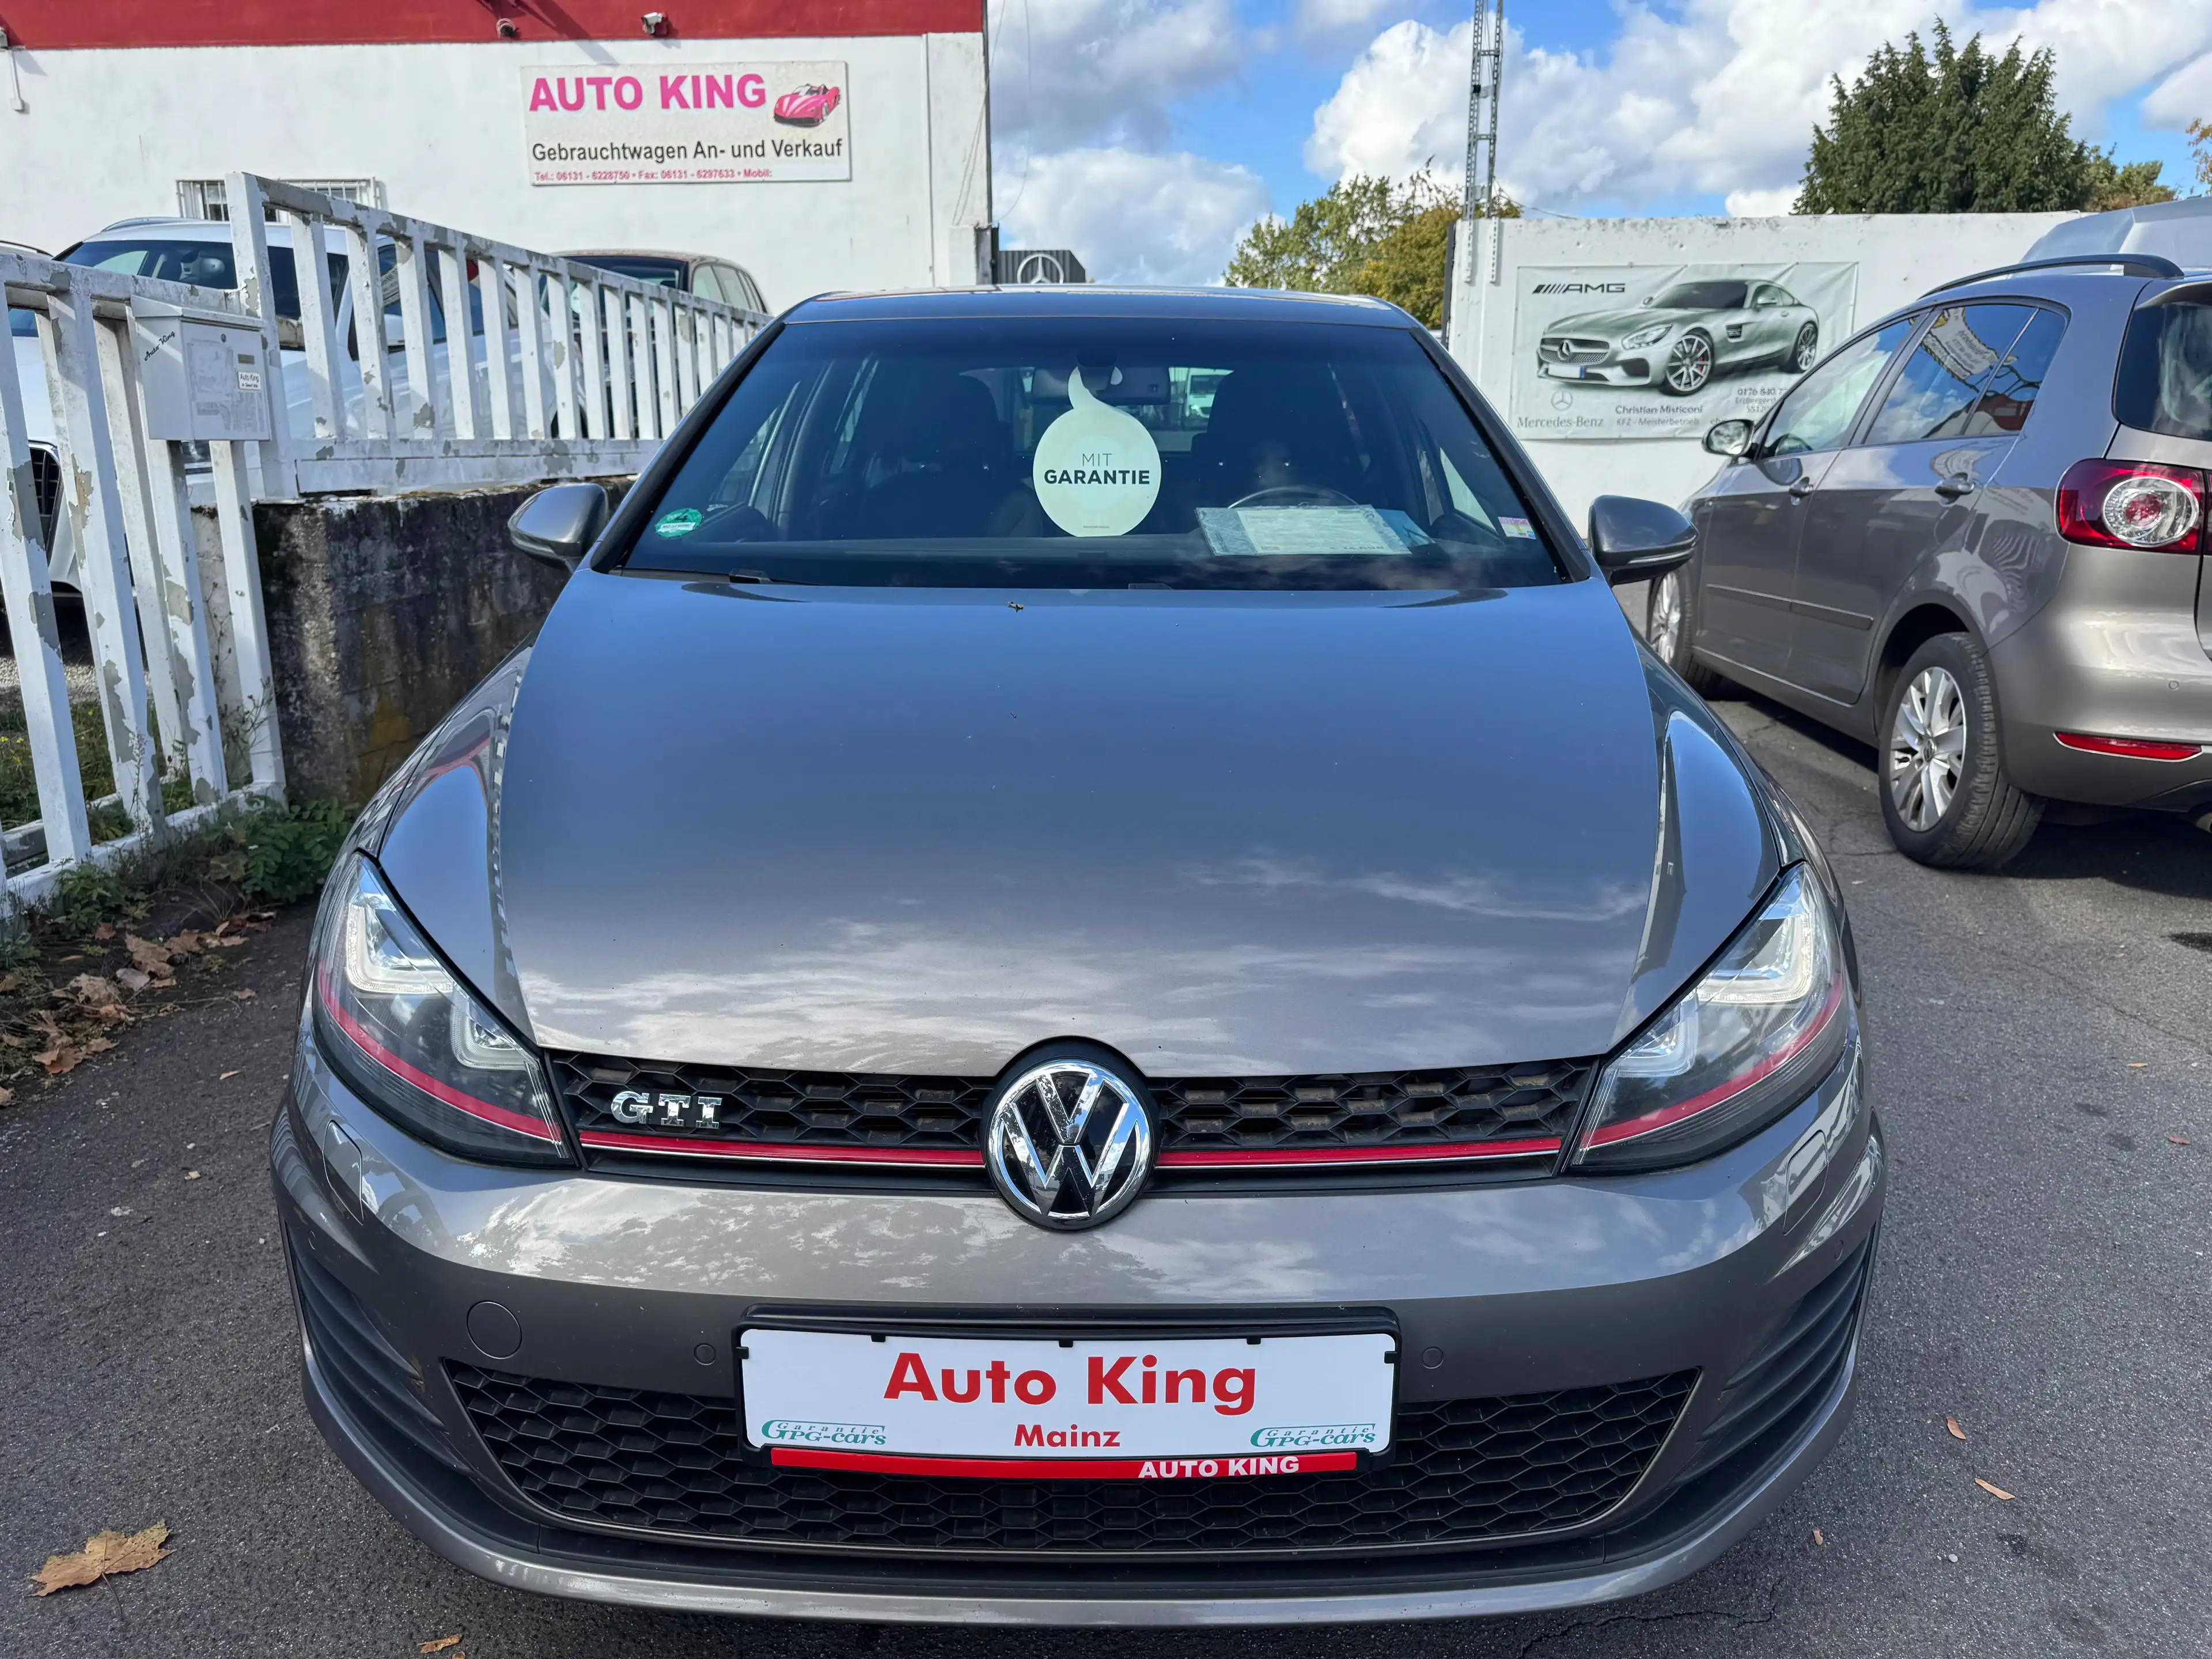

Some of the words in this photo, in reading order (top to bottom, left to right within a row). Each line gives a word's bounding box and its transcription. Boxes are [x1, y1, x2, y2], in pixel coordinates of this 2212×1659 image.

[529, 76, 643, 112] AUTO
[660, 73, 767, 109] KING
[532, 141, 688, 164] Gebrauchtwagen
[693, 141, 725, 160] An-
[731, 140, 765, 158] und
[771, 138, 843, 158] Verkauf
[556, 171, 584, 181] 06131
[638, 170, 658, 180] Fax:
[660, 169, 688, 179] 06131
[743, 168, 772, 178] Mobil:
[1562, 283, 1626, 294] AMG
[144, 343, 160, 362] Auto
[1615, 404, 1657, 415] Christian
[1517, 415, 1604, 429] Mercedes-Benz
[1082, 453, 1112, 467] MIT
[1044, 469, 1150, 484] GARANTIE
[611, 1090, 722, 1130] GTI
[883, 1352, 1057, 1405] Auto
[1088, 1354, 1256, 1416] King
[761, 1419, 887, 1445] GPG-cars
[777, 1422, 879, 1435] Garantie
[1014, 1423, 1121, 1447] Mainz
[1250, 1427, 1376, 1448] GPG-cars
[1267, 1426, 1369, 1437] Garantie
[1138, 1459, 1218, 1479] AUTO
[1228, 1456, 1300, 1476] KING
